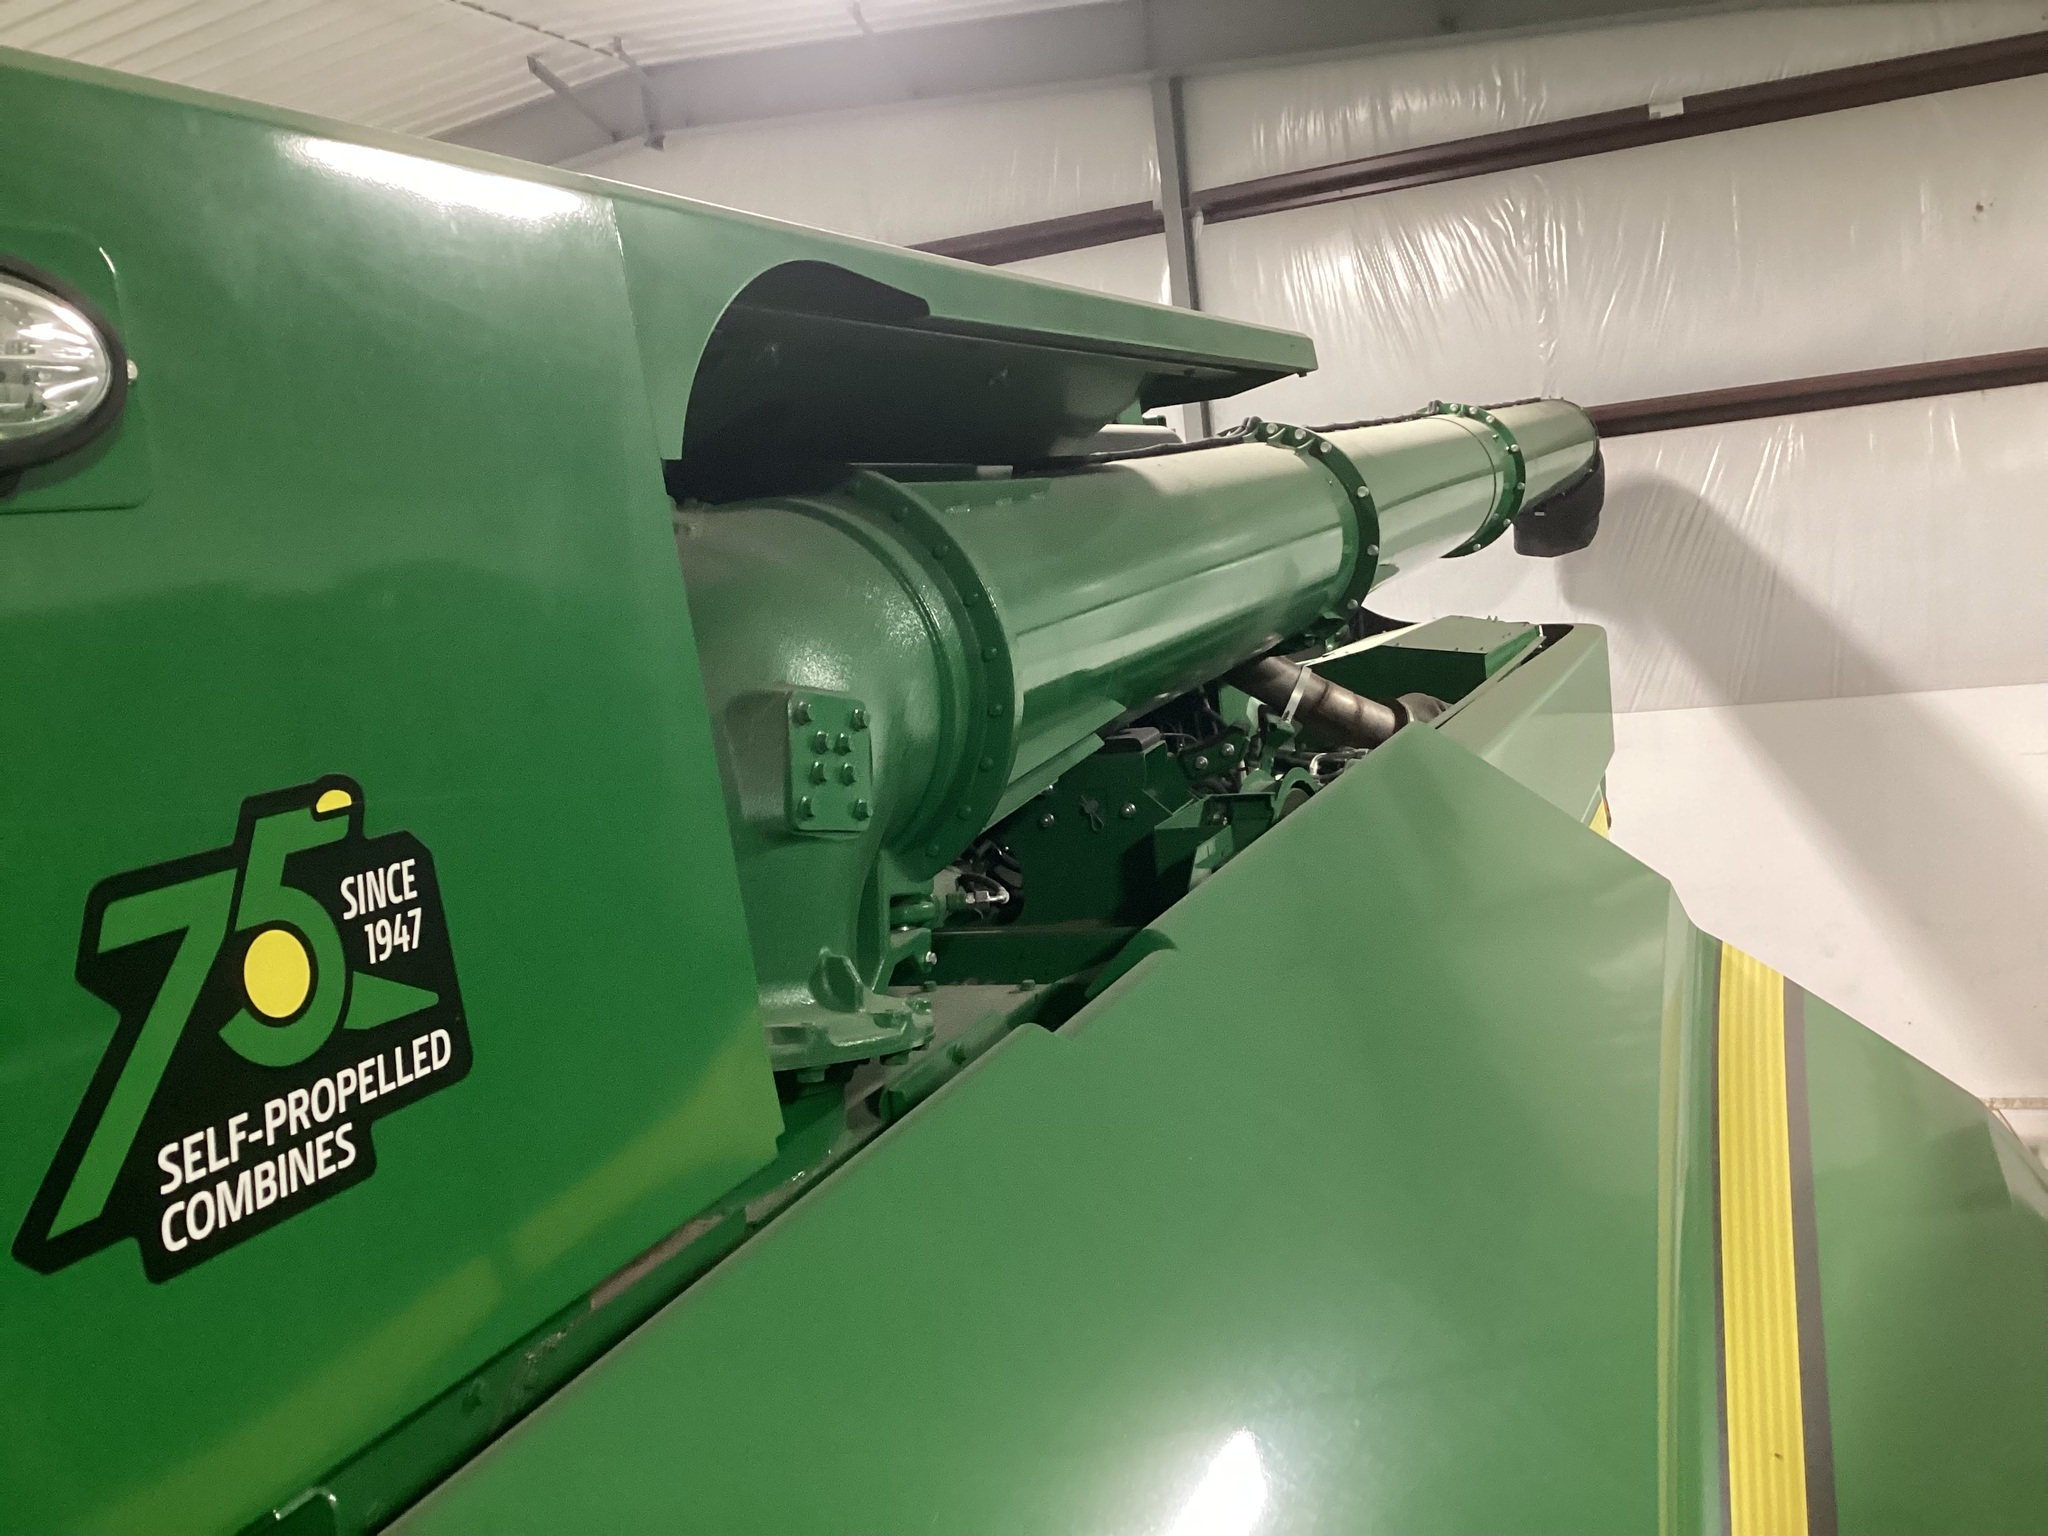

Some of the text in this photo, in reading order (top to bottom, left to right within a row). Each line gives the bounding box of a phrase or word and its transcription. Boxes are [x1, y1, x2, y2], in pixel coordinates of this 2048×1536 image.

[340, 858, 418, 920] SINCE
[364, 907, 422, 964] 1947
[157, 1028, 452, 1195] SELF-PROPELLED
[160, 1123, 357, 1252] COMBINES
